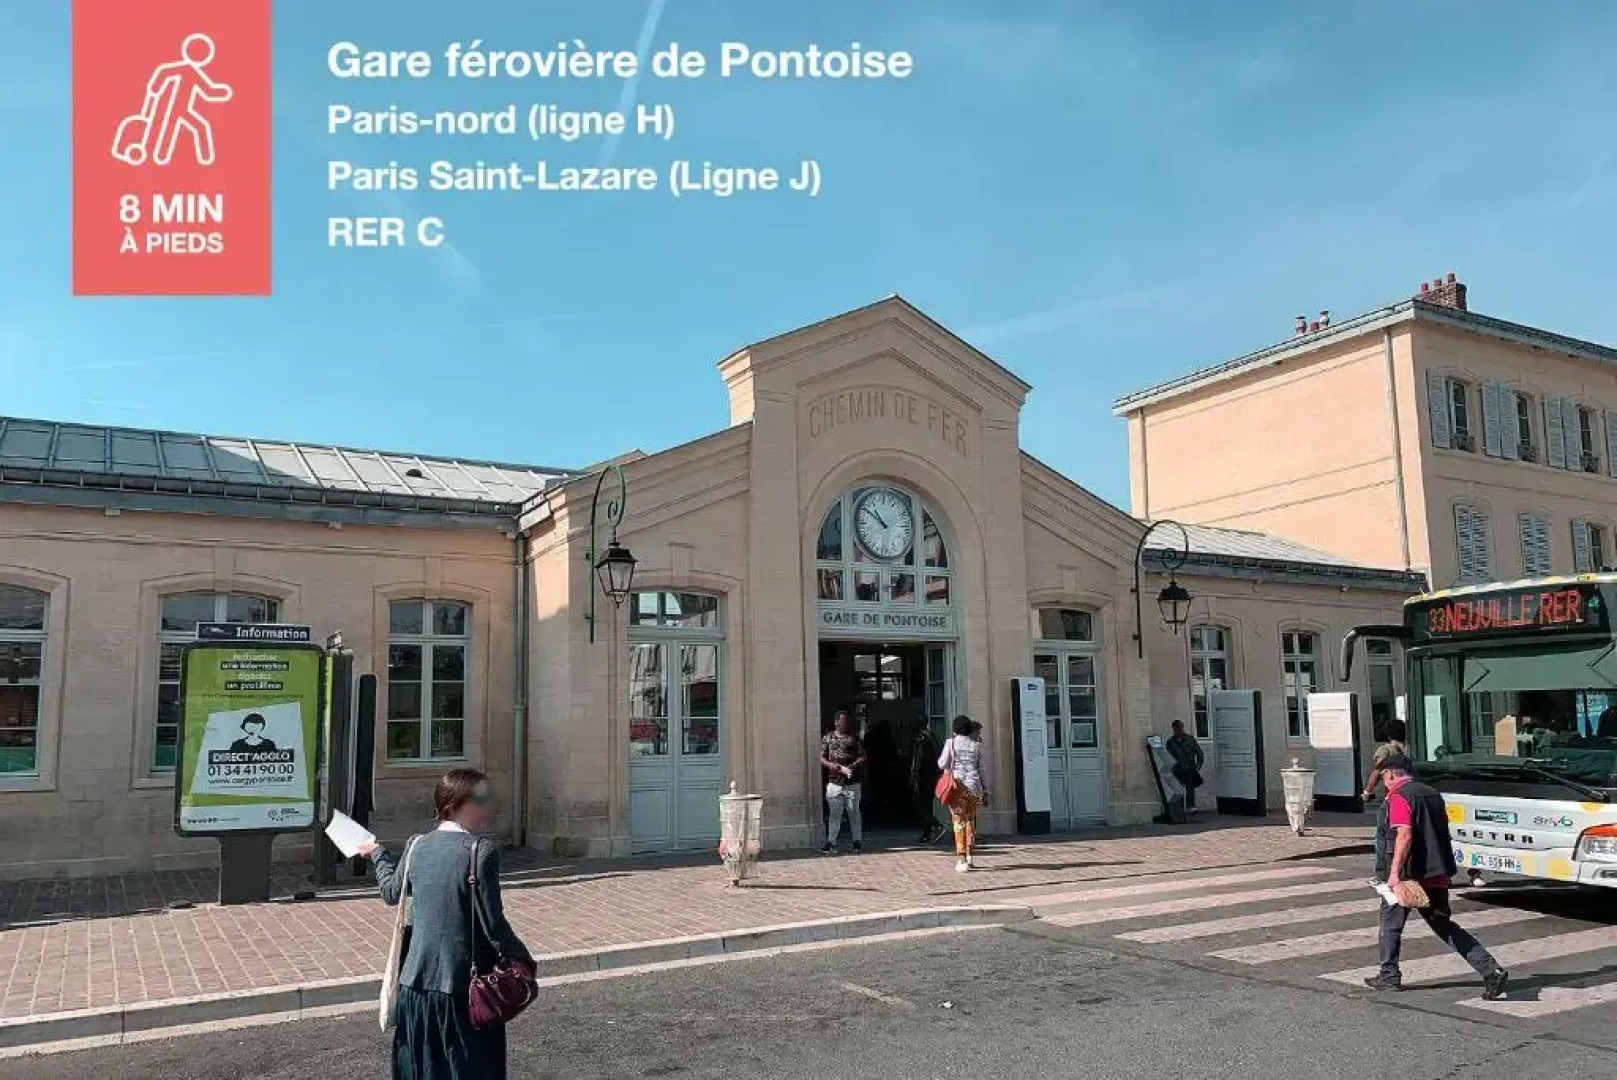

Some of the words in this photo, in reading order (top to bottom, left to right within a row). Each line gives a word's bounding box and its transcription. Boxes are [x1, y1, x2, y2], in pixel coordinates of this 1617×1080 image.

[809, 391, 885, 438] CHEMIN
[895, 392, 918, 424] DE
[928, 403, 968, 460] FER
[1446, 594, 1534, 632] NEUVILLE
[1539, 589, 1585, 623] RER
[823, 611, 858, 625] GARE
[863, 613, 880, 625] DE
[883, 614, 947, 628] PONTOISE
[236, 626, 308, 639] Information
[212, 751, 290, 762] DIRECT'AGGLO
[208, 765, 221, 776] 01
[224, 765, 241, 776] 34
[243, 765, 257, 776] 41
[260, 764, 276, 775] 90
[278, 763, 295, 775] 00
